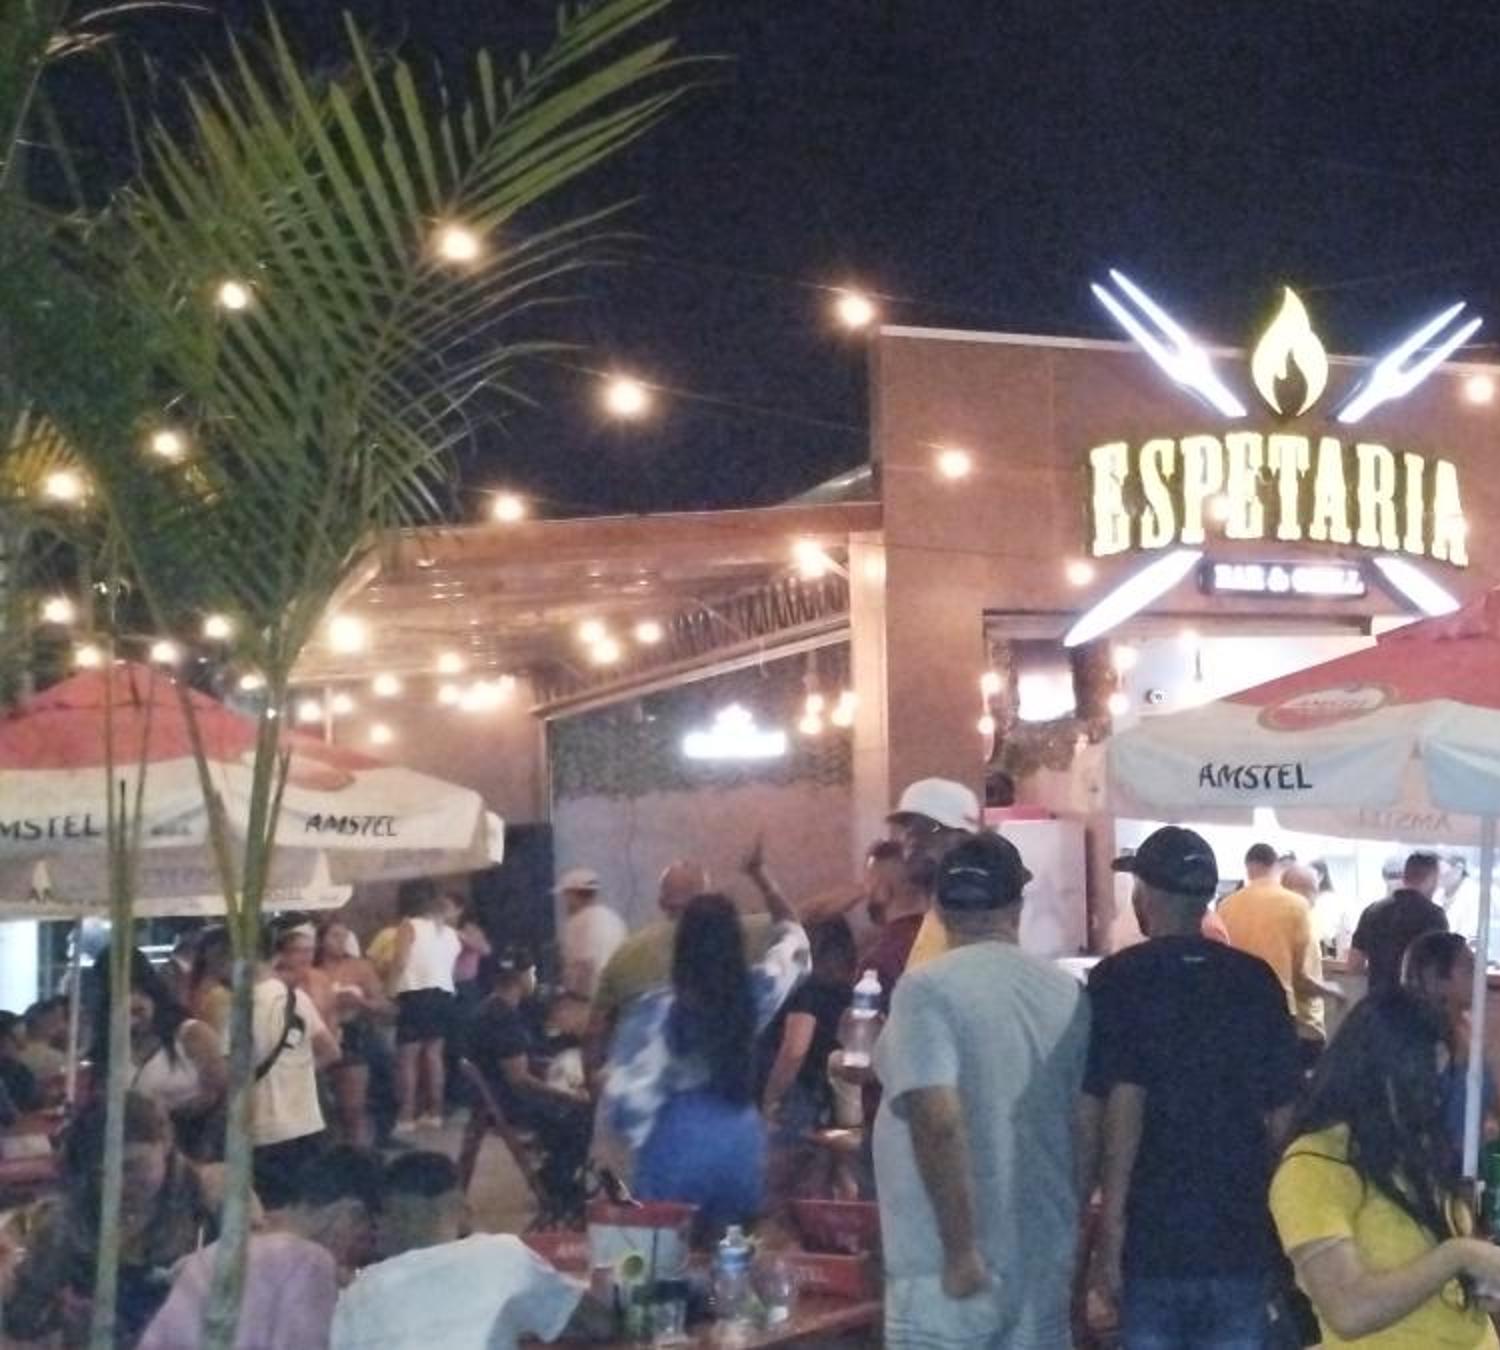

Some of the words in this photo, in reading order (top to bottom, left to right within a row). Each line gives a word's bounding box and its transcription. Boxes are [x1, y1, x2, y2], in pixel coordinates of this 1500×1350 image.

[1089, 431, 1470, 568] ESPETARIA
[1199, 762, 1313, 790] AMSTEL
[0, 813, 102, 840] MSTEL
[304, 813, 398, 838] AMSTEL
